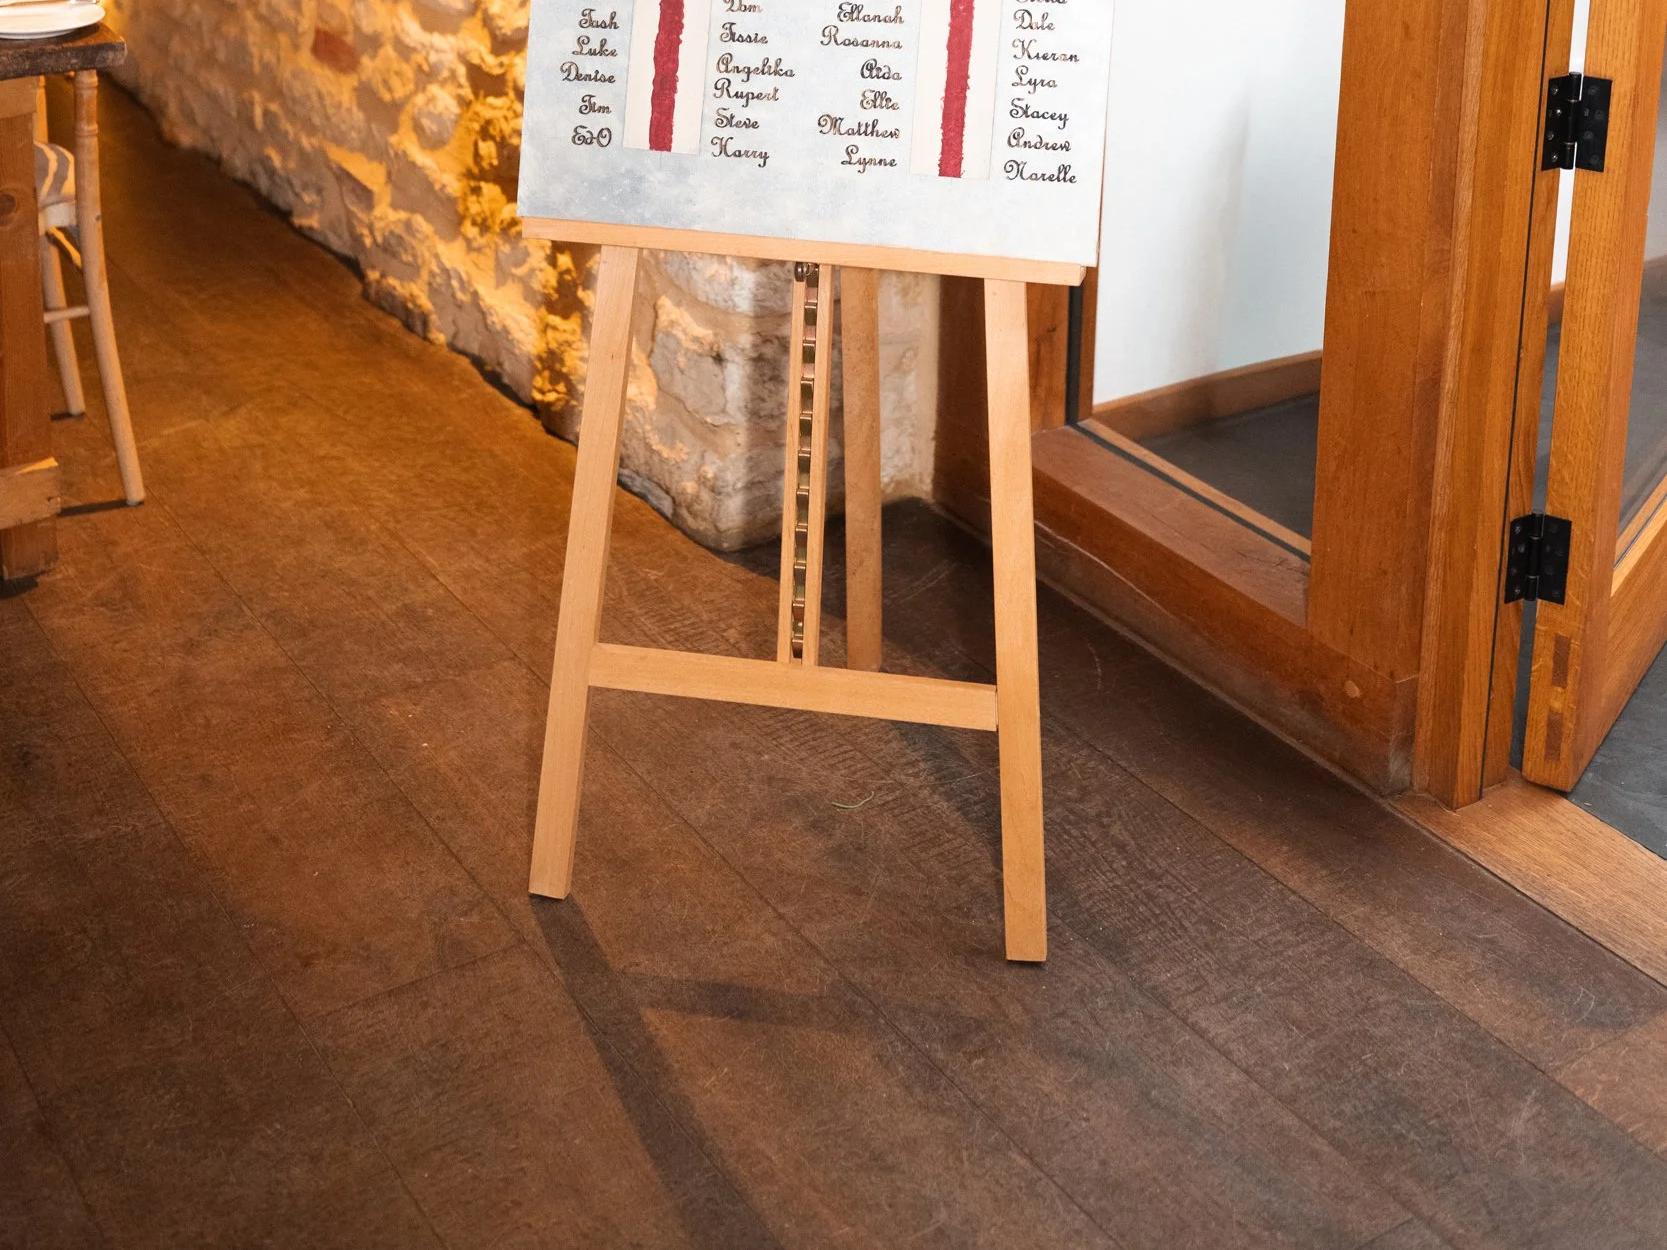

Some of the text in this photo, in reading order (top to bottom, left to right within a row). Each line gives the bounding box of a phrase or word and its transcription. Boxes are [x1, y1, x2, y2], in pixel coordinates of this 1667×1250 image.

[578, 9, 619, 29] Tash
[837, 2, 904, 24] Ellanah
[1014, 10, 1055, 31] Dale
[572, 36, 617, 57] Luke
[821, 25, 902, 50] Rosanna
[1012, 40, 1079, 63] Kieran
[560, 62, 615, 83] Denise
[716, 53, 795, 82] Angelika
[860, 58, 902, 81] Aida
[1011, 66, 1057, 94] Lyra
[579, 95, 611, 114] Tim
[714, 79, 779, 107] Rupert
[860, 90, 899, 110] Ellie
[715, 109, 760, 129] Steve
[1010, 98, 1069, 129] Stacey
[818, 114, 900, 139] Matthew
[1007, 127, 1071, 152] Andrew
[711, 137, 769, 167] Harry
[841, 144, 897, 173] Lynne
[1004, 161, 1077, 184] Narelle
